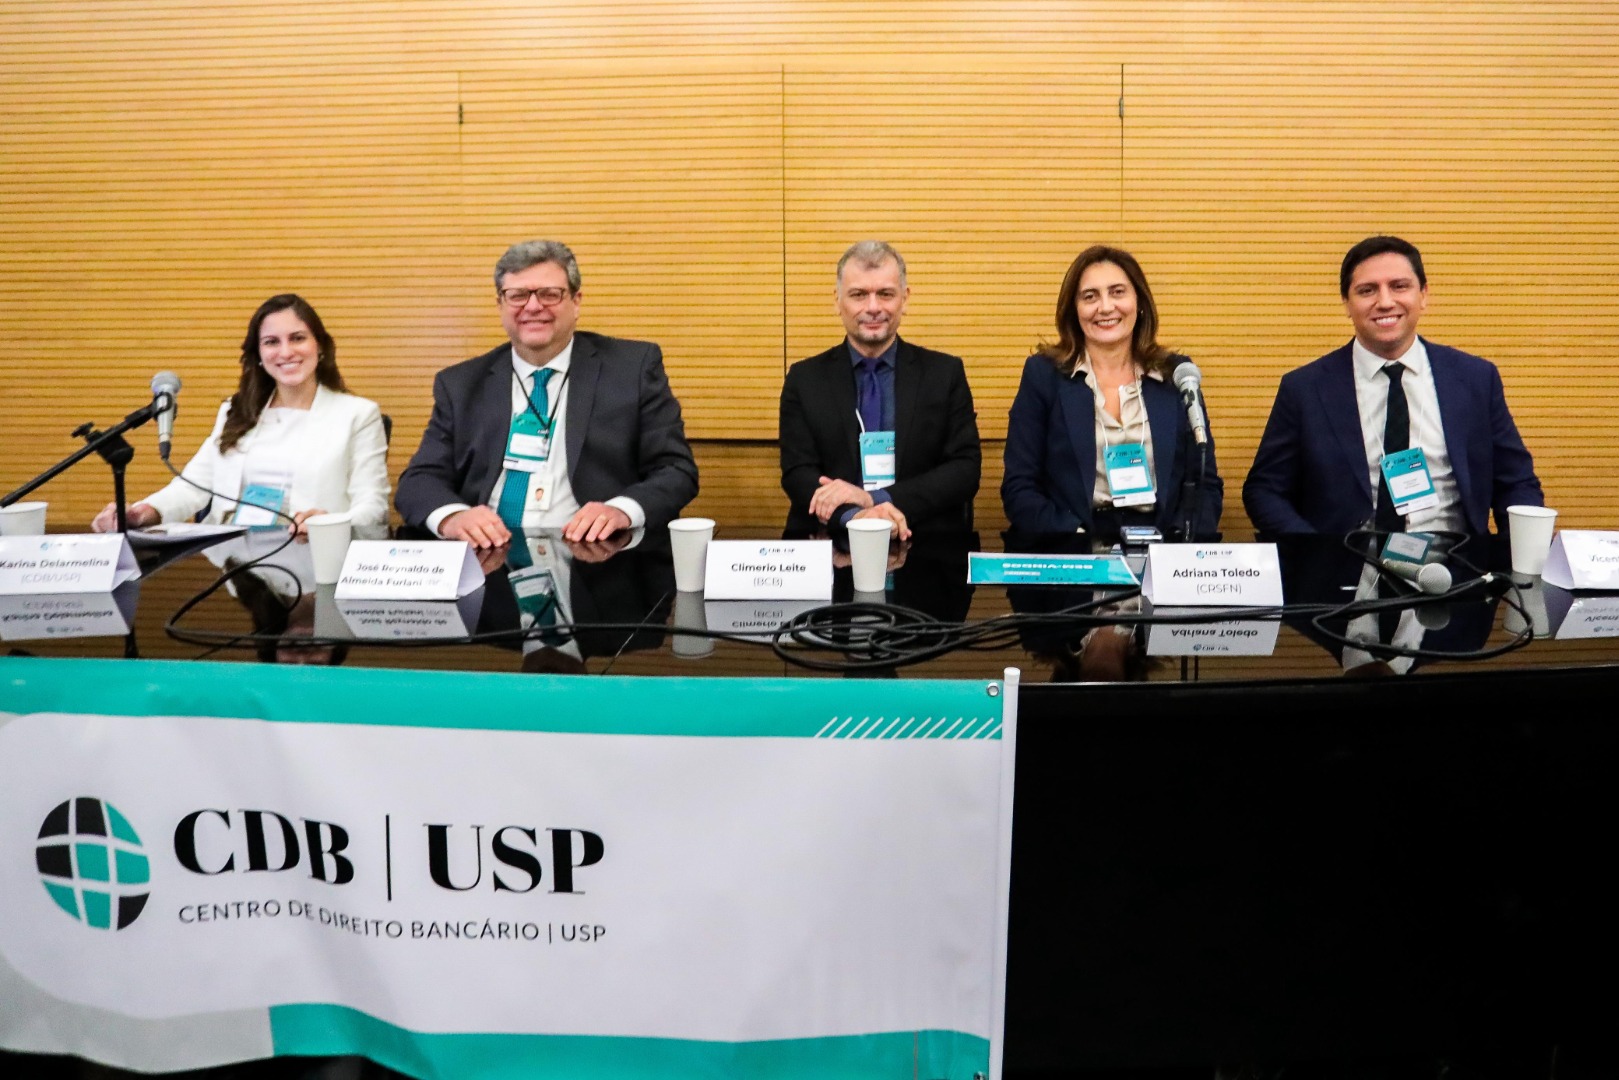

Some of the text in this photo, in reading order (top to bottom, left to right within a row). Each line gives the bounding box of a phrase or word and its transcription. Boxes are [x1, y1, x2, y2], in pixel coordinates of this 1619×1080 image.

[40, 558, 110, 568] Delarmelina
[731, 563, 807, 573] Climerio Leite
[356, 563, 379, 572] José
[431, 566, 445, 574] de
[1172, 568, 1260, 578] Adriana Toledo
[340, 576, 384, 585] Almeida
[1196, 583, 1242, 594] (CRSFN)
[174, 808, 605, 895] CDB USP
[178, 899, 607, 943] CENTRO DE DIREITO BANCÁRIO USP
